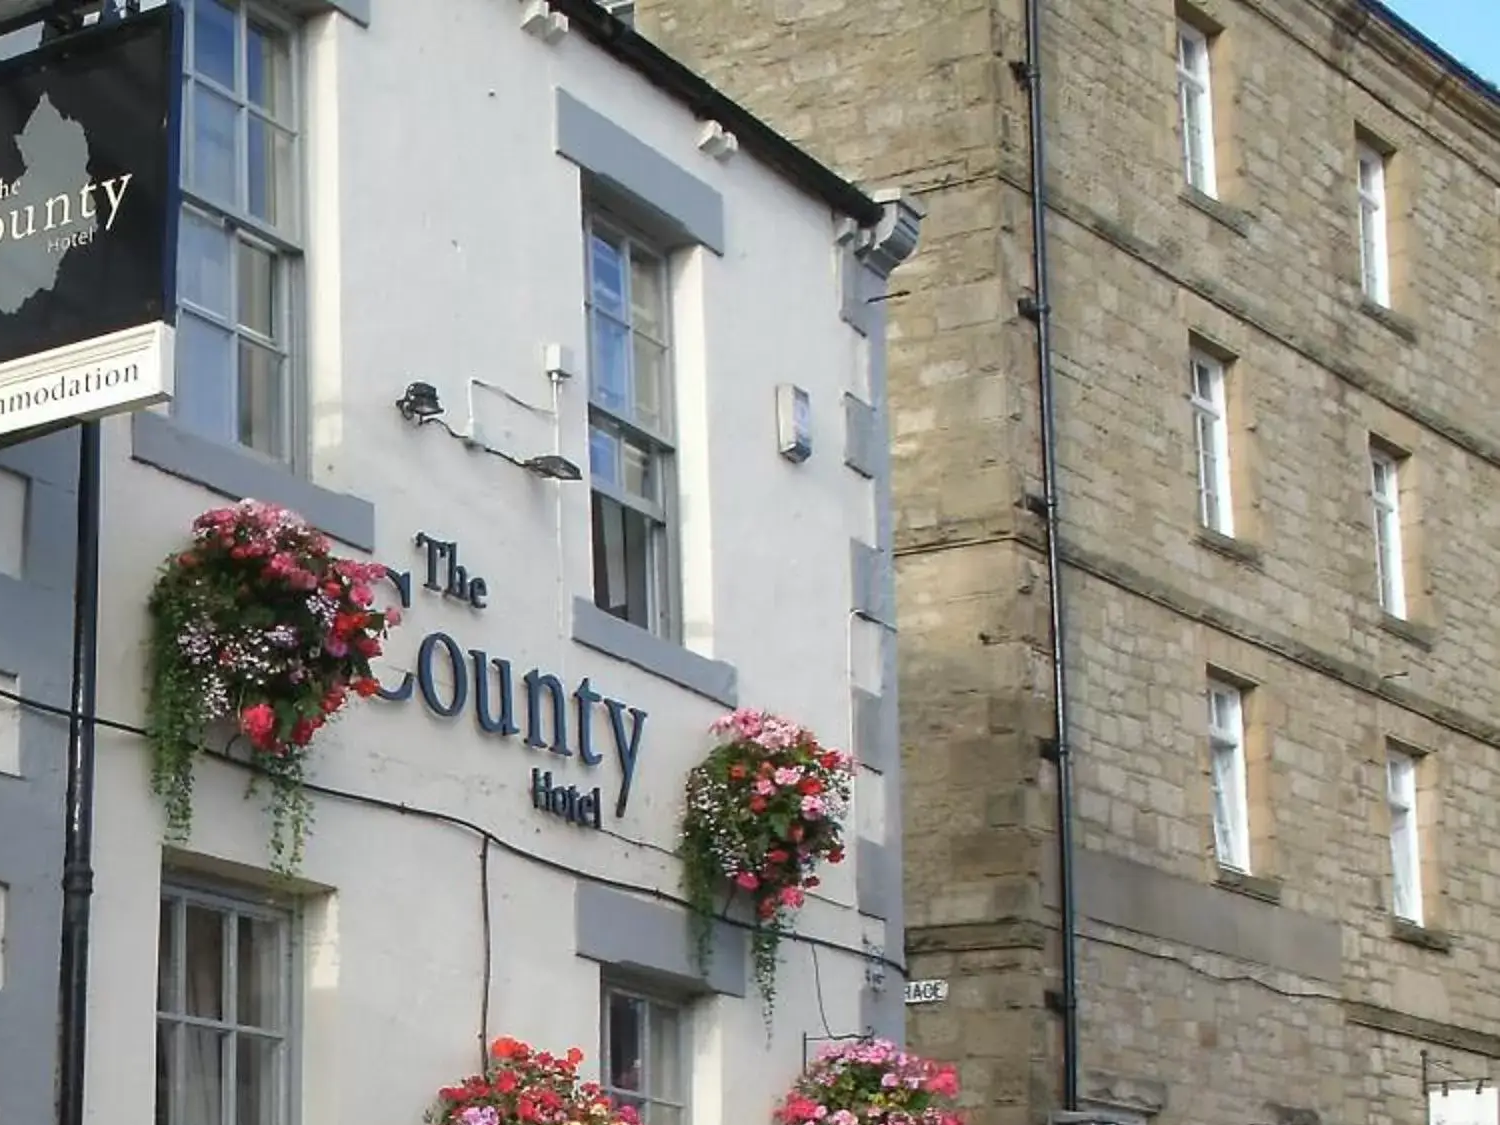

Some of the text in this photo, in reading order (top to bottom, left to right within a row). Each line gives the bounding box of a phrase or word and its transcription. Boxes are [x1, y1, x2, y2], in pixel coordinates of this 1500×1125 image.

[47, 225, 95, 254] Hotel
[414, 531, 488, 609] The
[530, 766, 601, 829] Hotel
